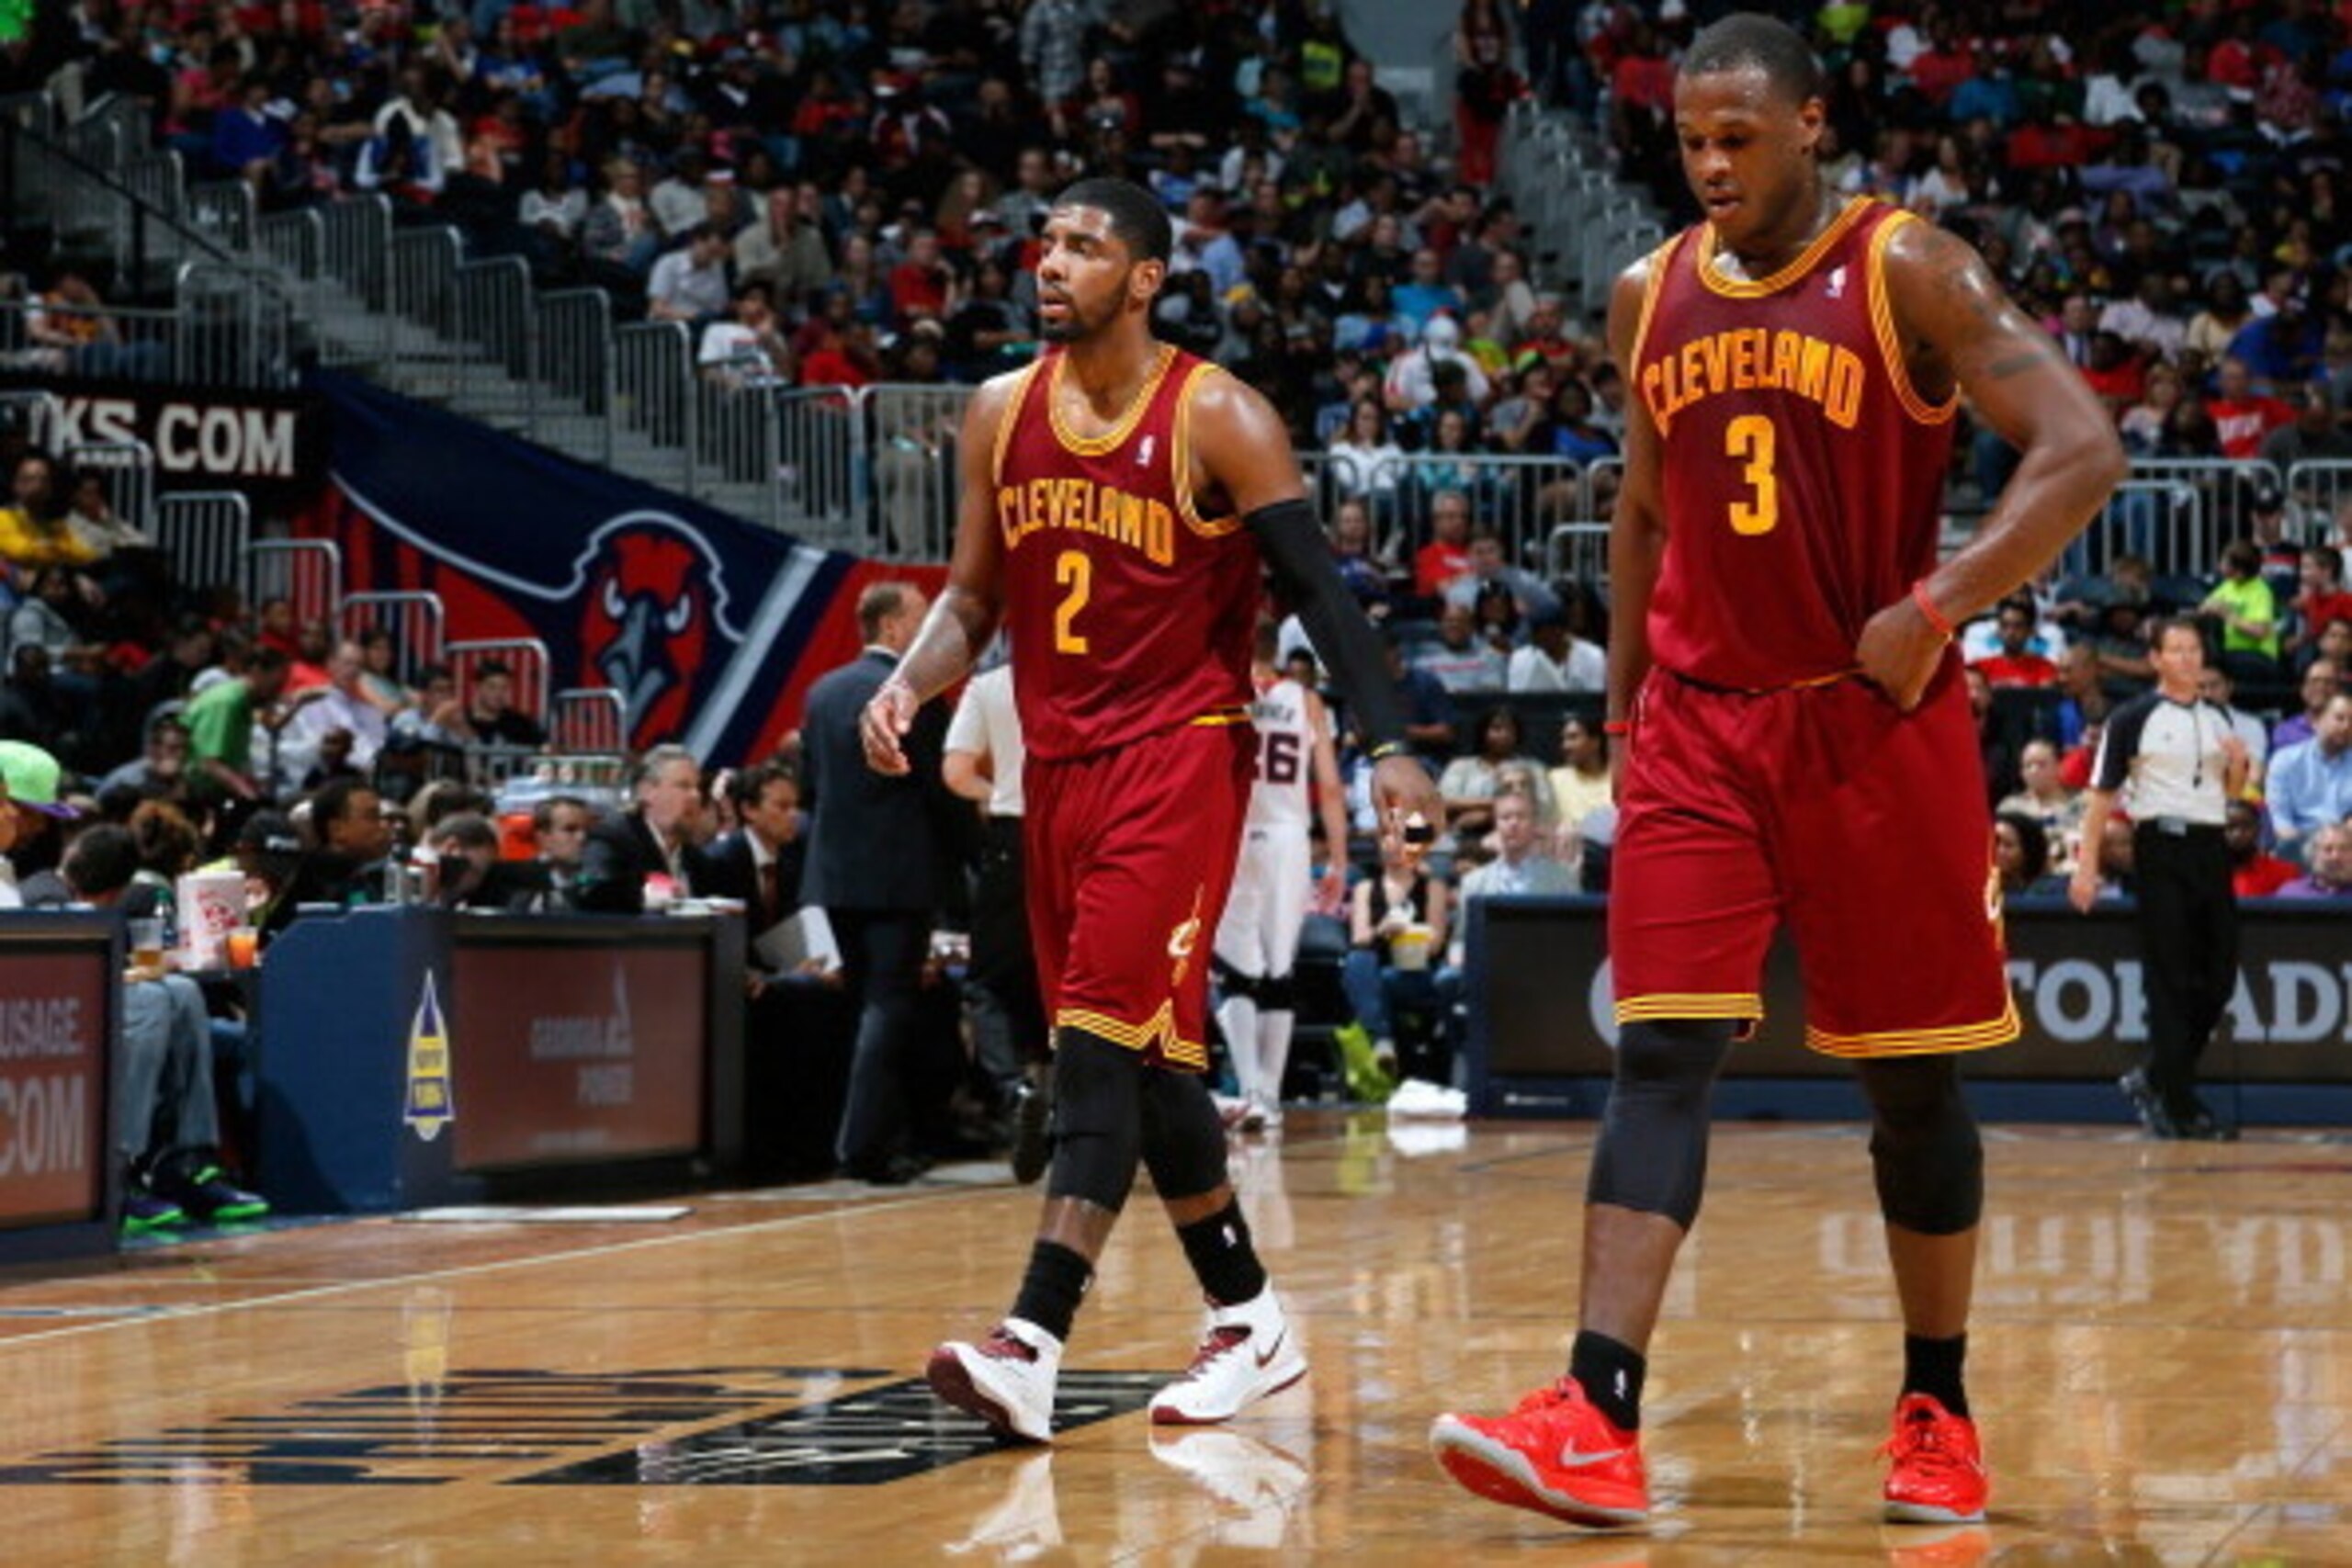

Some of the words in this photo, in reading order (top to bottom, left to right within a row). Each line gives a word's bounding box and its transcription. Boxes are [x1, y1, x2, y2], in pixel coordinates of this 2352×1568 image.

[1643, 327, 1866, 440] CLEVELAND
[28, 397, 295, 478] KS.COM
[1725, 414, 1779, 536] 3
[998, 478, 1175, 568] CLEVELAND
[1056, 550, 1091, 655] 2
[1255, 732, 1300, 785] 6
